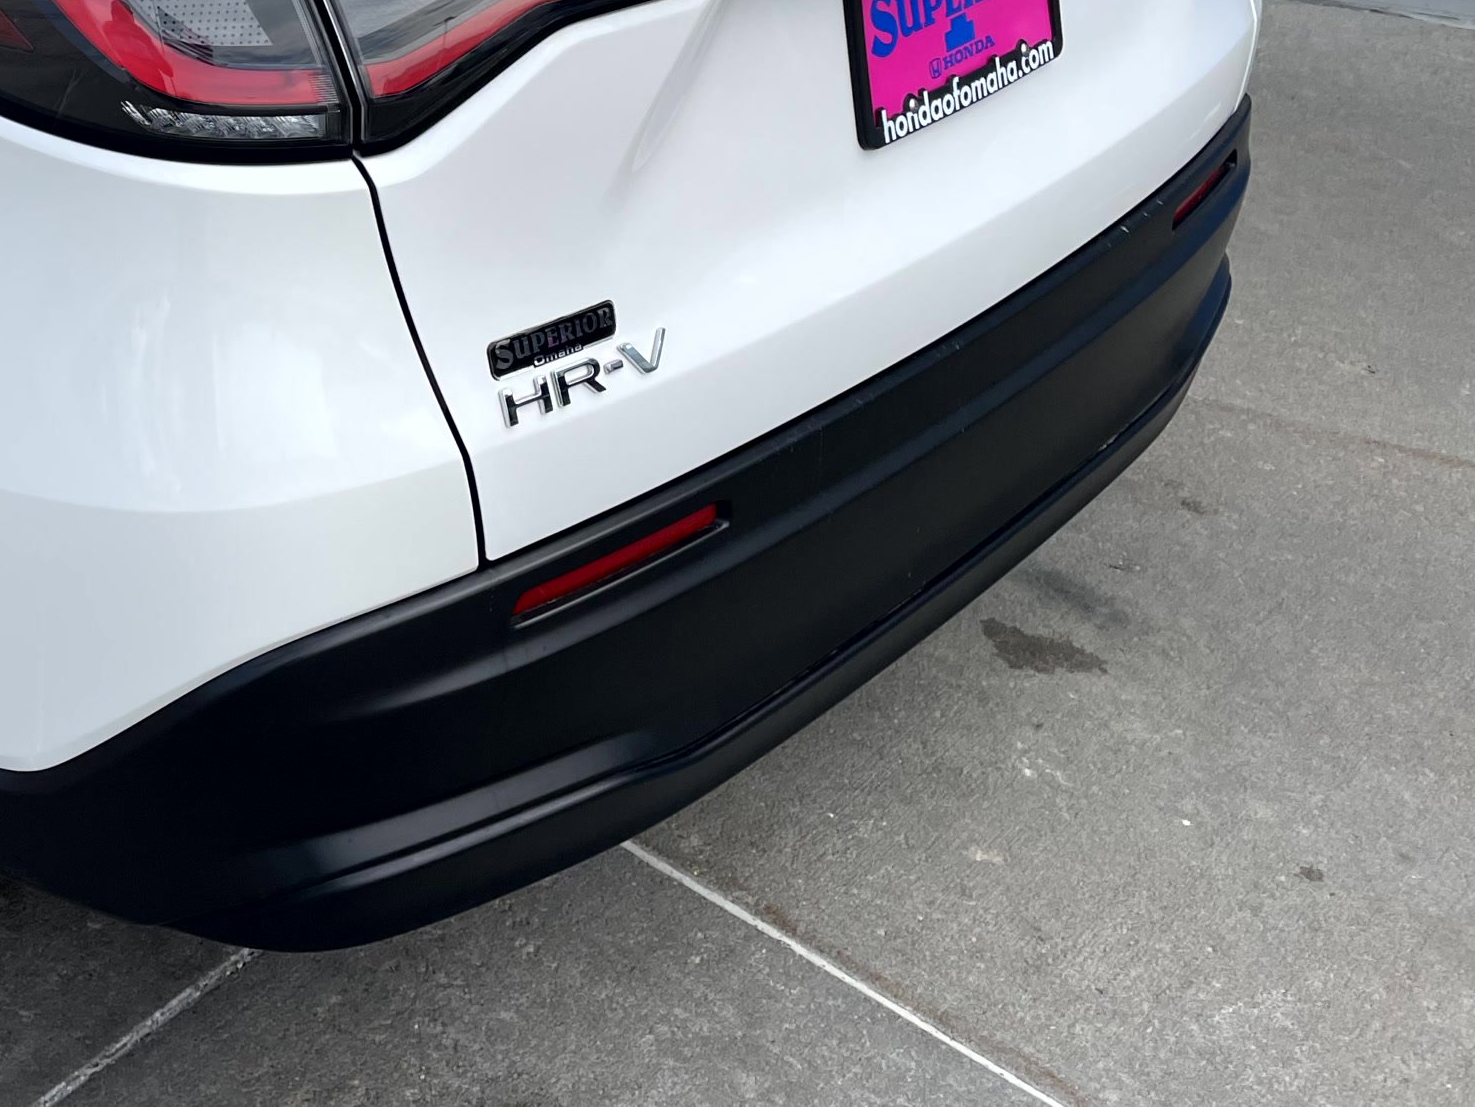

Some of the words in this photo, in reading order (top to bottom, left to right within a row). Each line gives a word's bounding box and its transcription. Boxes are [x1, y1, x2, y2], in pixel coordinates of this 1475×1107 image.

[943, 35, 996, 70] HONDA
[881, 40, 1055, 143] hondaofomaha.com
[495, 307, 614, 370] SUPERIOR
[533, 343, 583, 366] Omaha
[498, 327, 666, 428] HR-V
